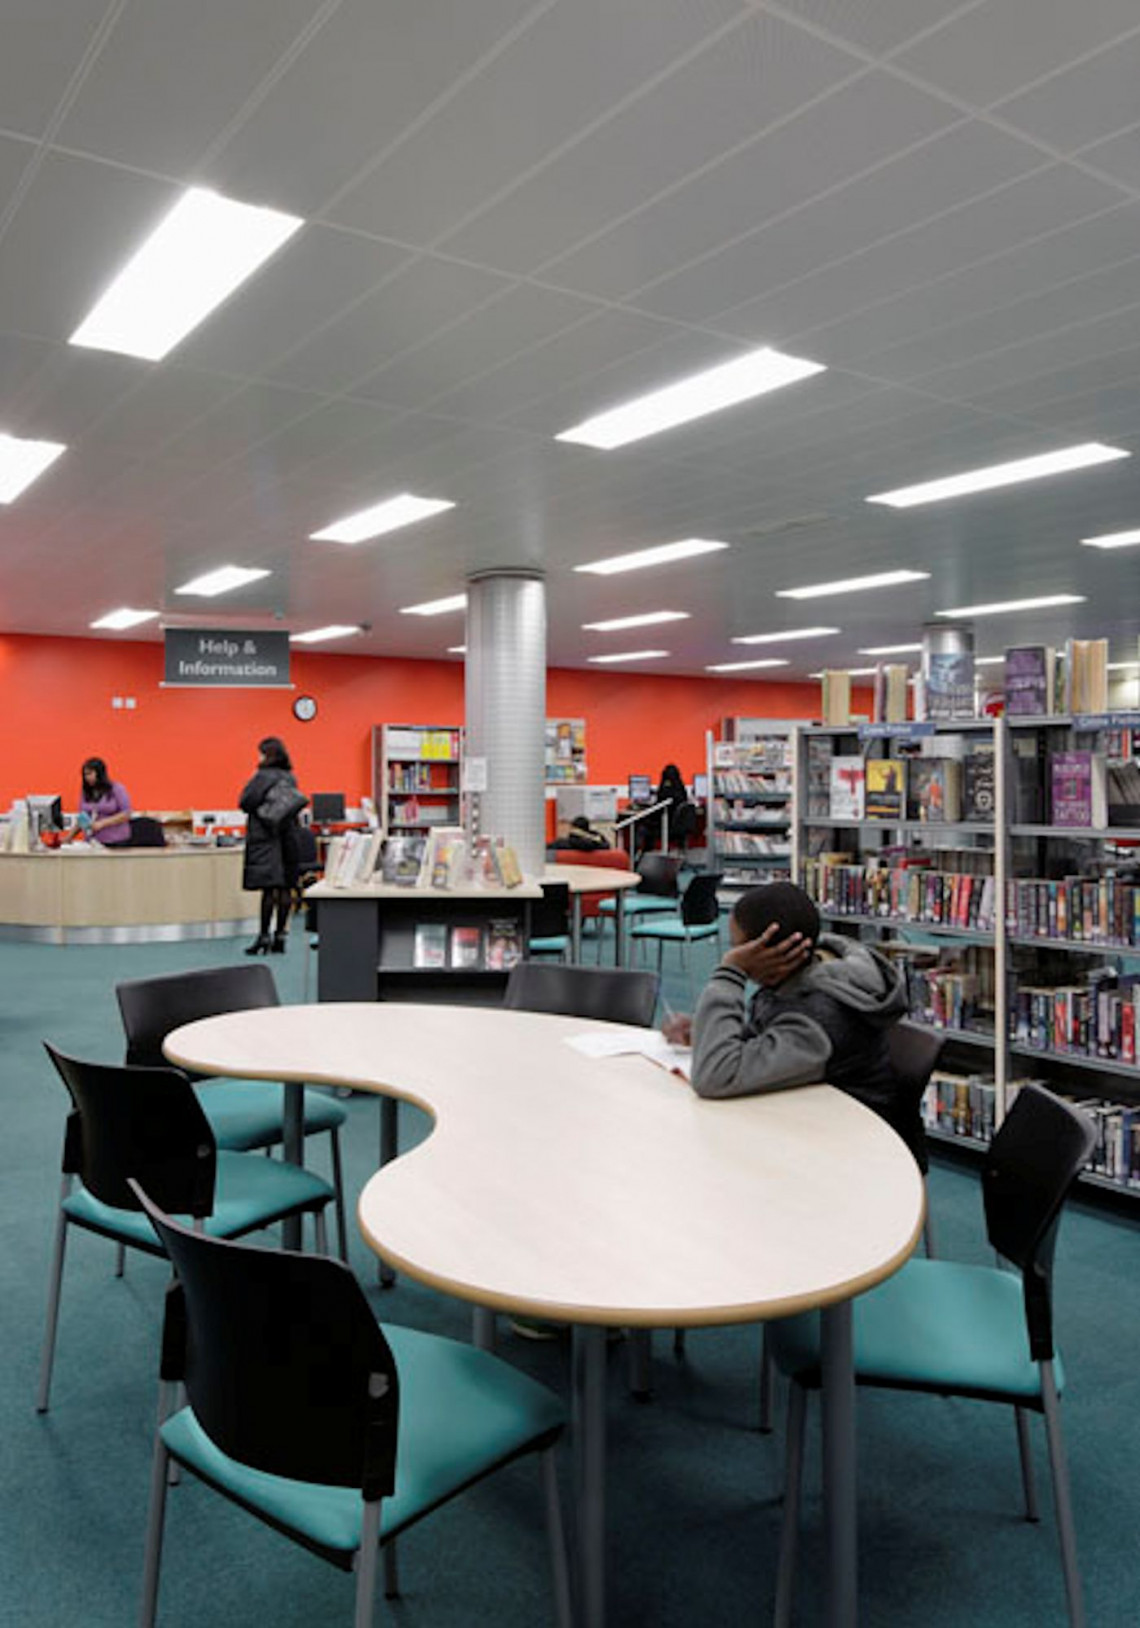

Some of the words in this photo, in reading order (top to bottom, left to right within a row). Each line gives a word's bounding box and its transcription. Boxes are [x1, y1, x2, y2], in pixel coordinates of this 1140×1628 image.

[199, 638, 239, 658] Help
[243, 639, 257, 654] &
[179, 660, 277, 676] Information
